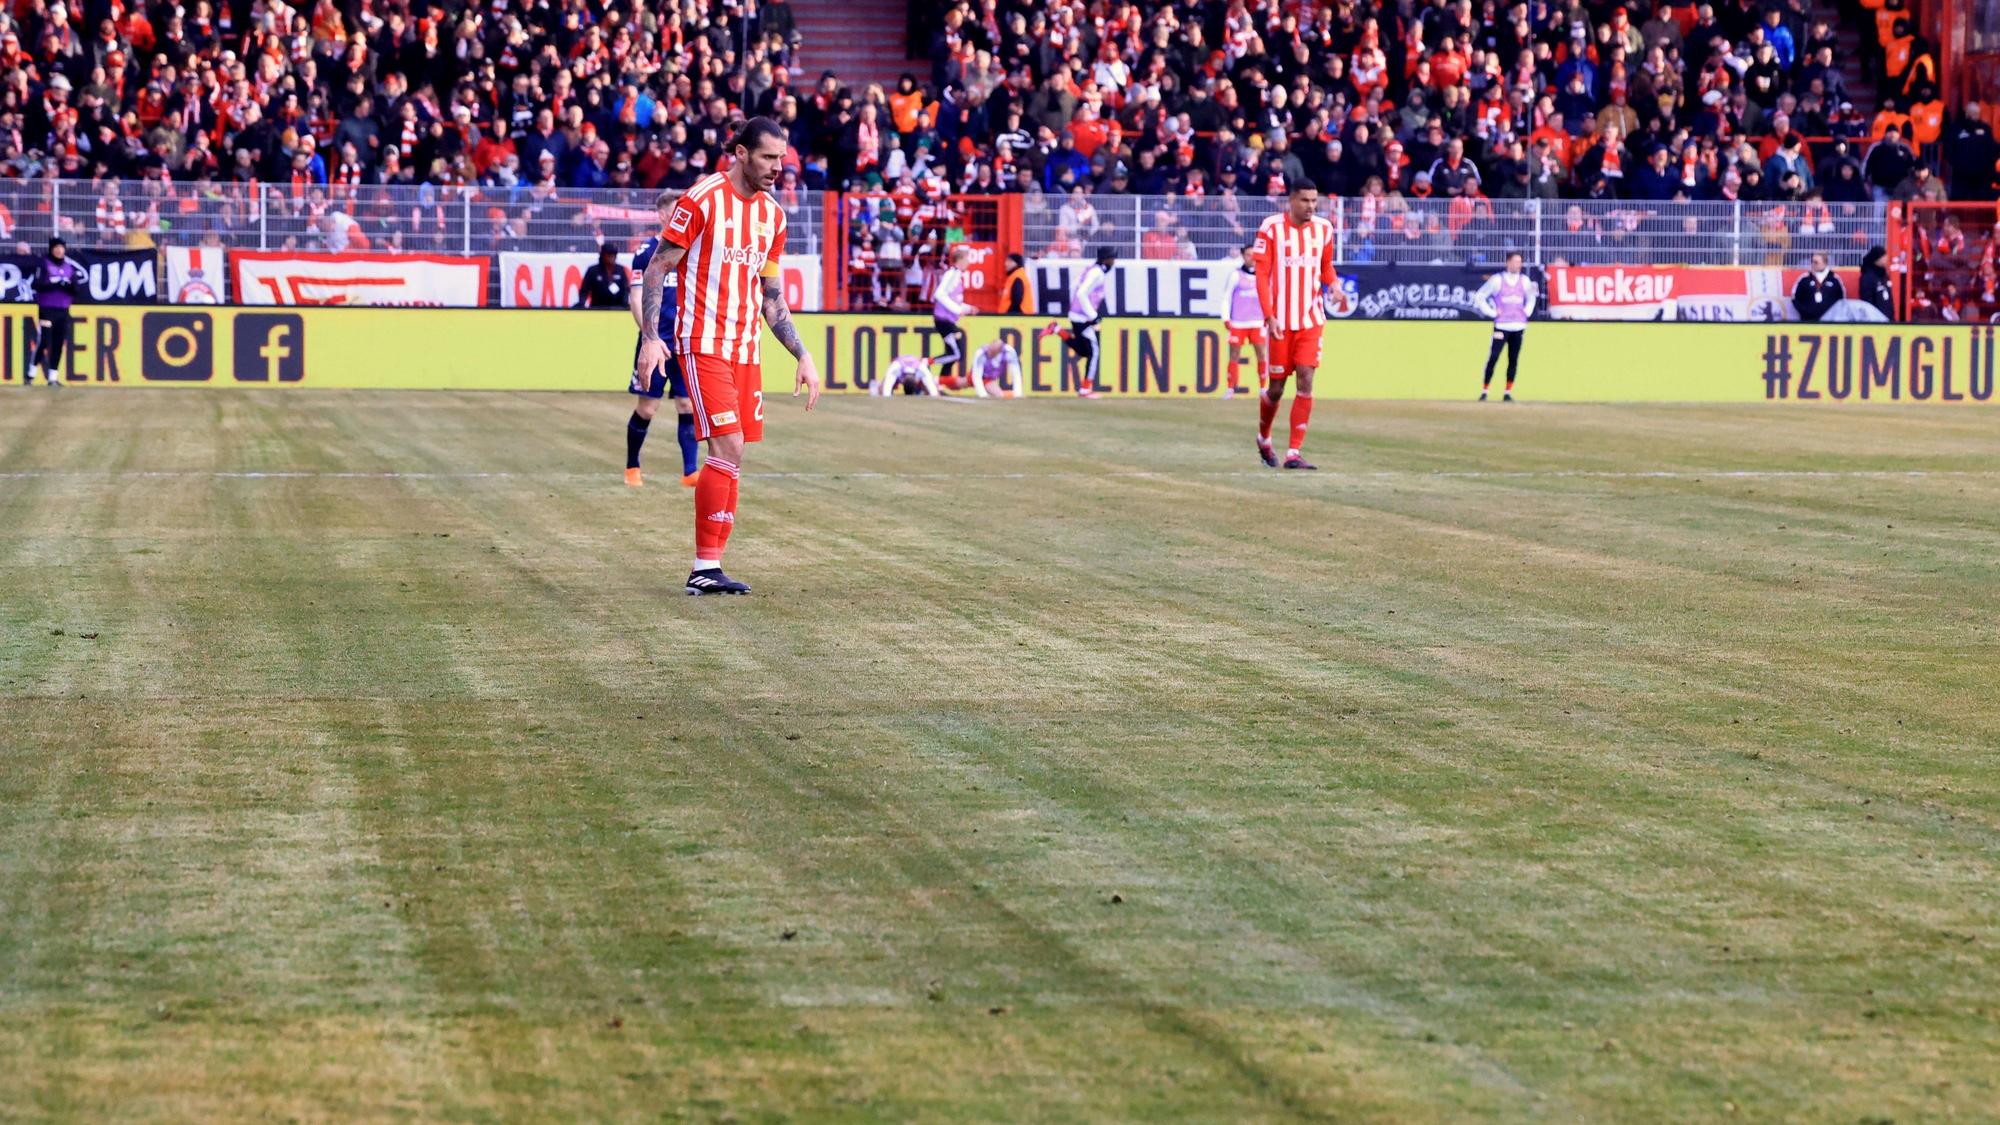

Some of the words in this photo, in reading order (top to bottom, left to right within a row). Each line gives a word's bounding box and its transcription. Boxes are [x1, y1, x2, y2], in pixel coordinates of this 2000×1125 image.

[961, 269, 985, 289] 10
[1556, 268, 1674, 303] Luckau
[1762, 325, 1994, 401] #ZUMGLÜ
